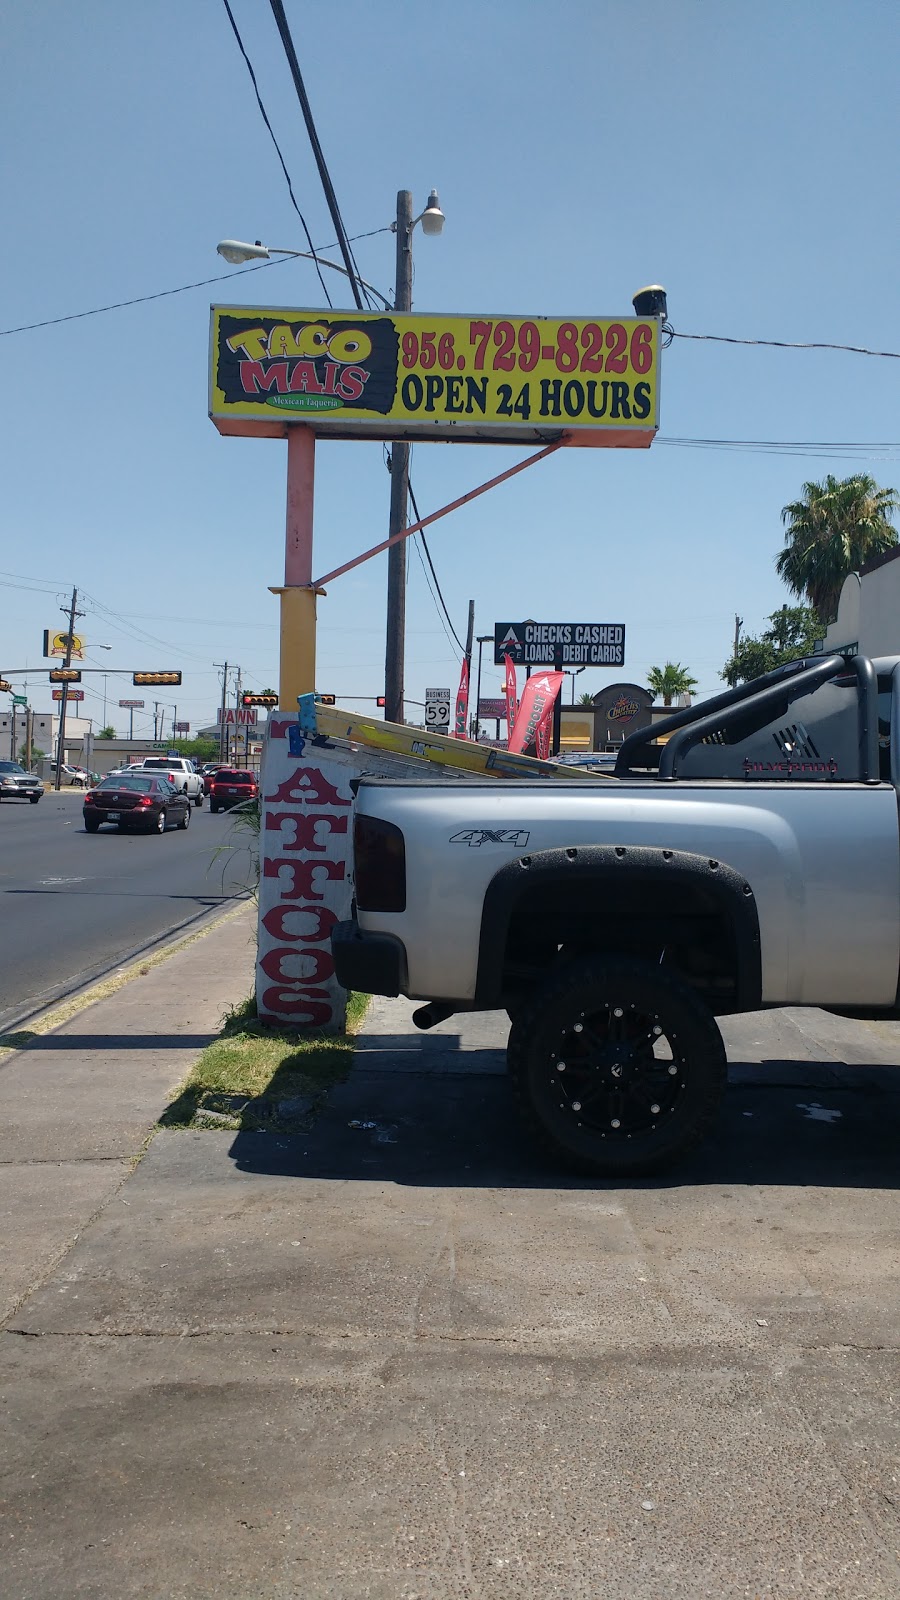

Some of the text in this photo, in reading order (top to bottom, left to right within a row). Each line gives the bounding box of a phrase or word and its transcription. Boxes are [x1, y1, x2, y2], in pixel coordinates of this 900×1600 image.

[226, 324, 373, 364] TACO
[402, 321, 653, 374] 956.729-8226
[238, 360, 371, 400] MAIS
[272, 396, 304, 405] Mexican
[401, 373, 652, 420] OPEN 24 HOURS
[525, 625, 623, 644] CHECKS CASHED
[499, 651, 522, 659] ACE
[524, 644, 622, 663] LOANS DEBIT CARDS
[428, 706, 448, 720] 59
[523, 693, 547, 744] DEPOSIT
[742, 761, 838, 772] SILVERADO
